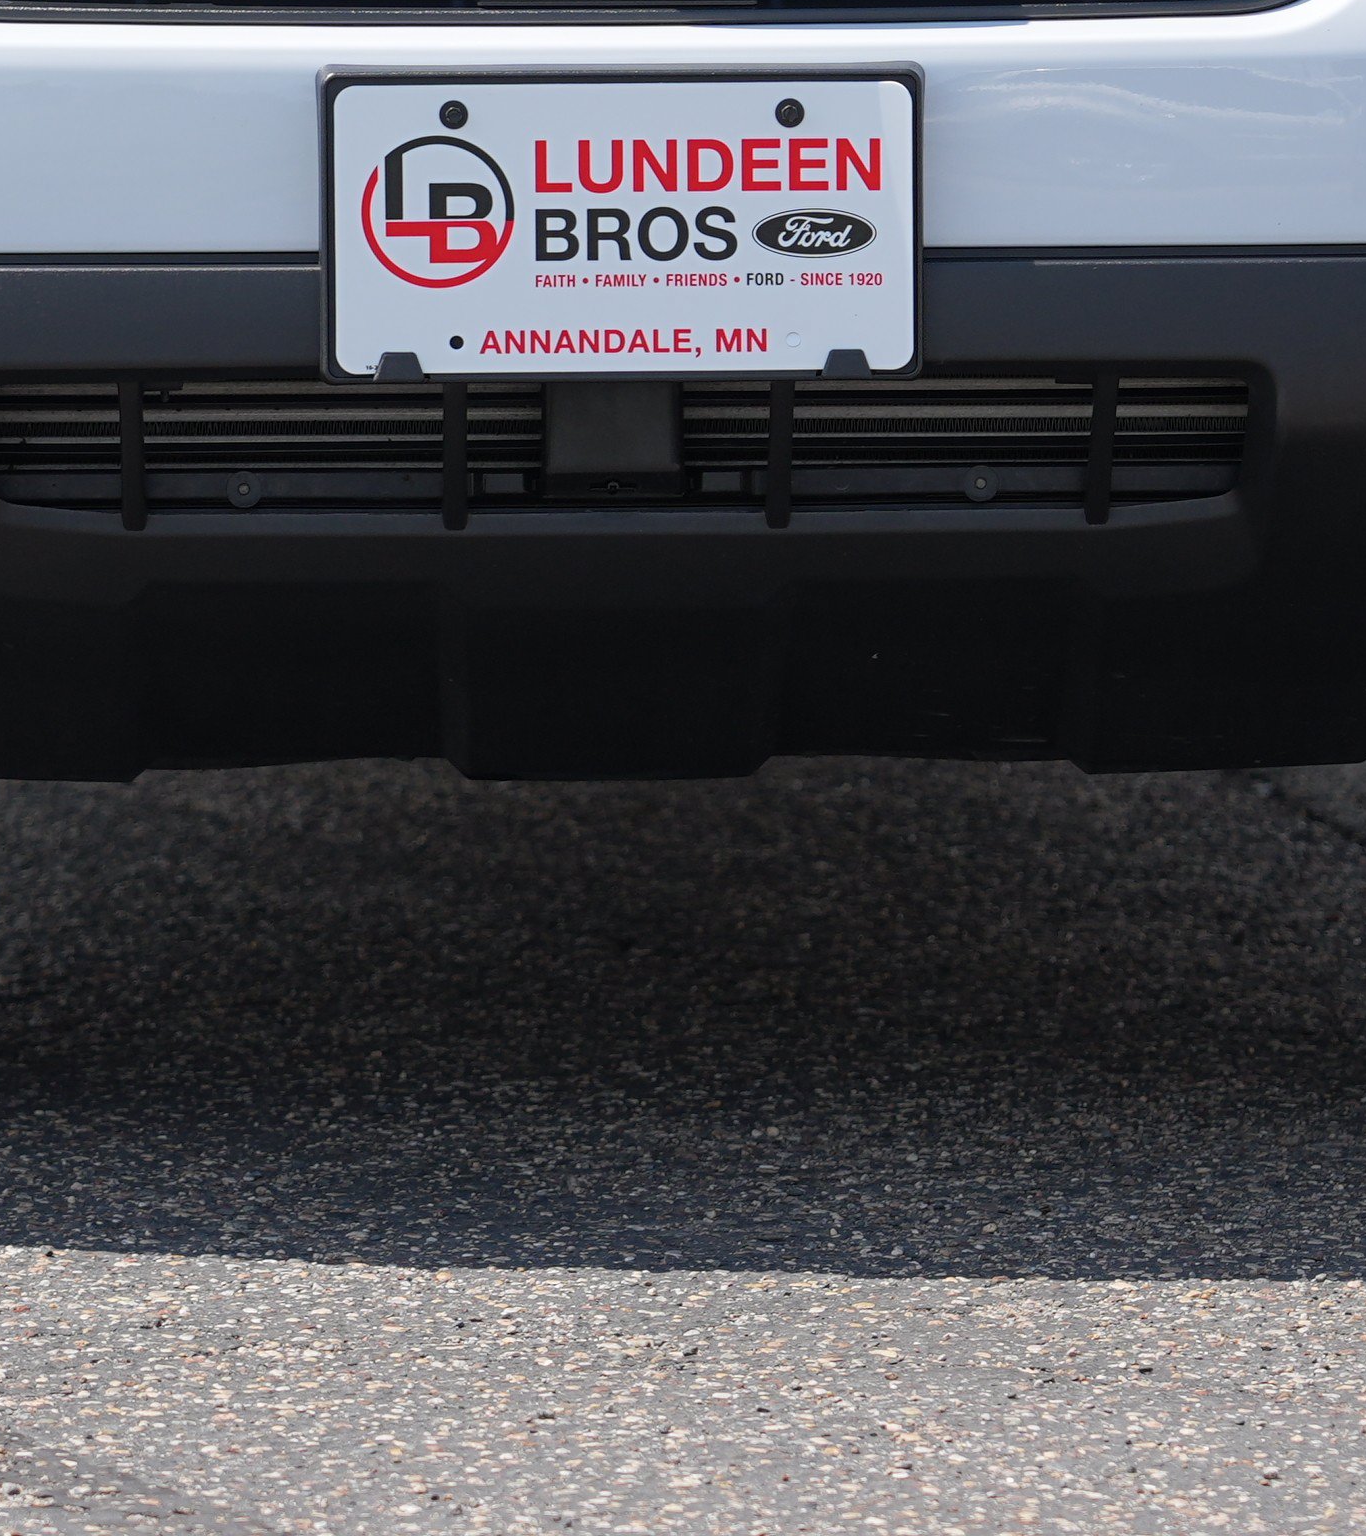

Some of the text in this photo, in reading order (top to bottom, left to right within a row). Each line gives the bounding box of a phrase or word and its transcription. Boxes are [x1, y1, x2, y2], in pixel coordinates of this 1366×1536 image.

[535, 138, 881, 194] LUNDEEN
[535, 206, 738, 262] BROS
[777, 215, 854, 250] Ford
[535, 272, 884, 288] FAITH FAMILY FRIENDS FORD SINCE 1920
[479, 327, 768, 359] ANNANDALE, MN
